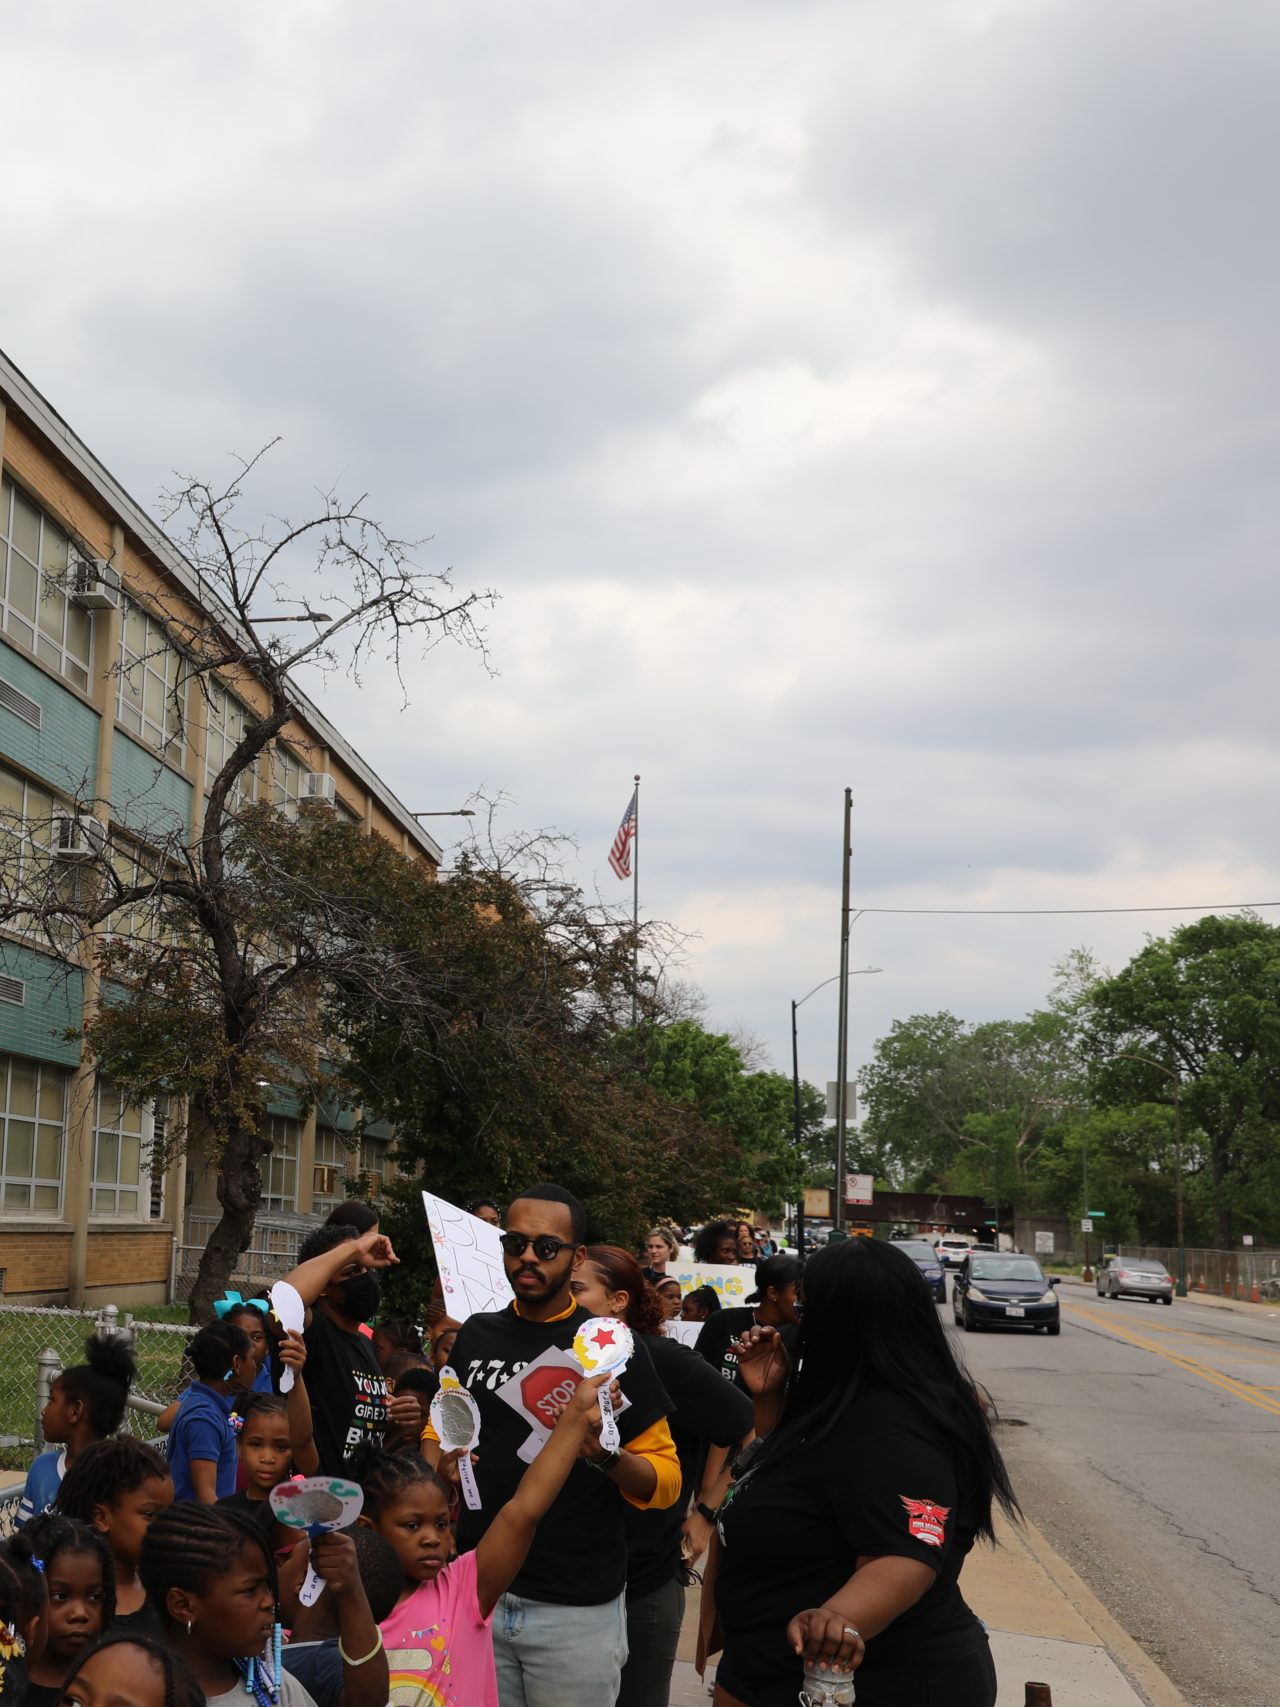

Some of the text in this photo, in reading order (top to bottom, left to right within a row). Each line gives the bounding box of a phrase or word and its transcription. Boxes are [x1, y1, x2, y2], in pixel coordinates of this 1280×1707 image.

[353, 1376, 389, 1395] YOUN
[536, 1379, 577, 1416] STOP
[607, 1421, 616, 1436] am
[606, 1440, 616, 1448] I
[310, 1575, 318, 1589] am
